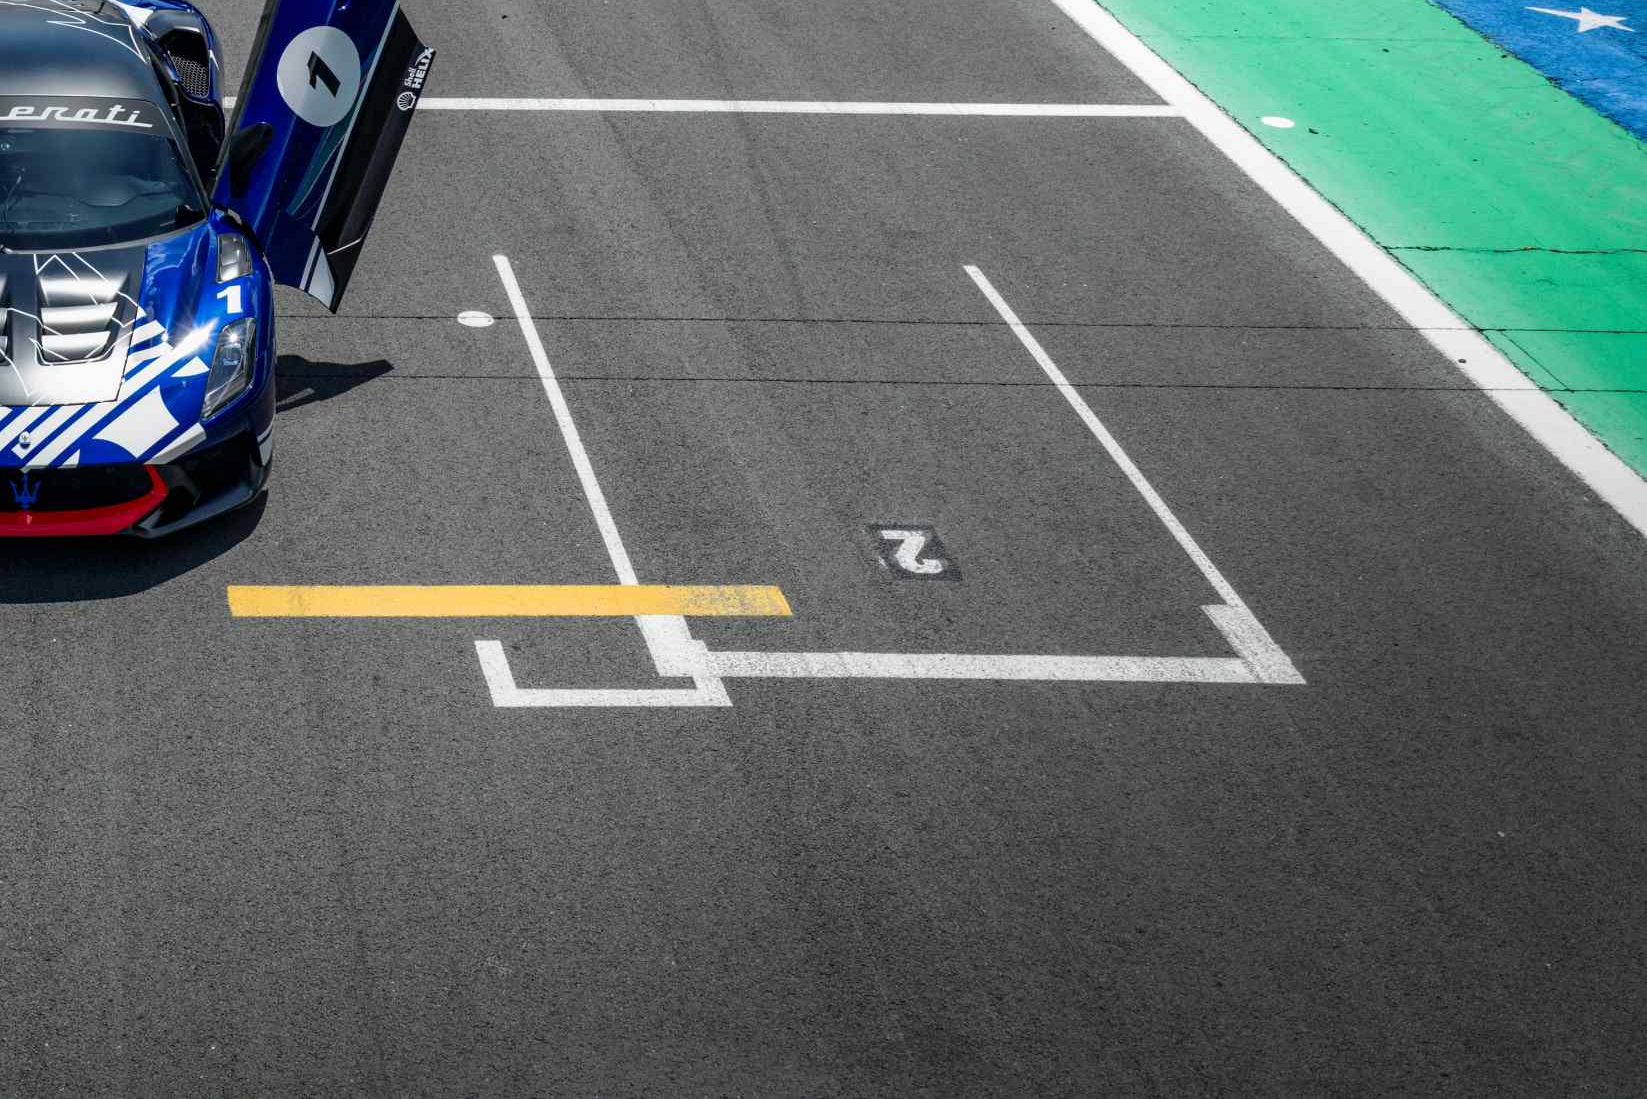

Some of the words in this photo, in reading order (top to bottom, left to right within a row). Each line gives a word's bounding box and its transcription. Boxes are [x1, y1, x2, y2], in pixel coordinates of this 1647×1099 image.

[307, 50, 341, 99] 1
[411, 46, 435, 89] HELIX
[217, 285, 243, 314] 1
[880, 530, 943, 574] 2
